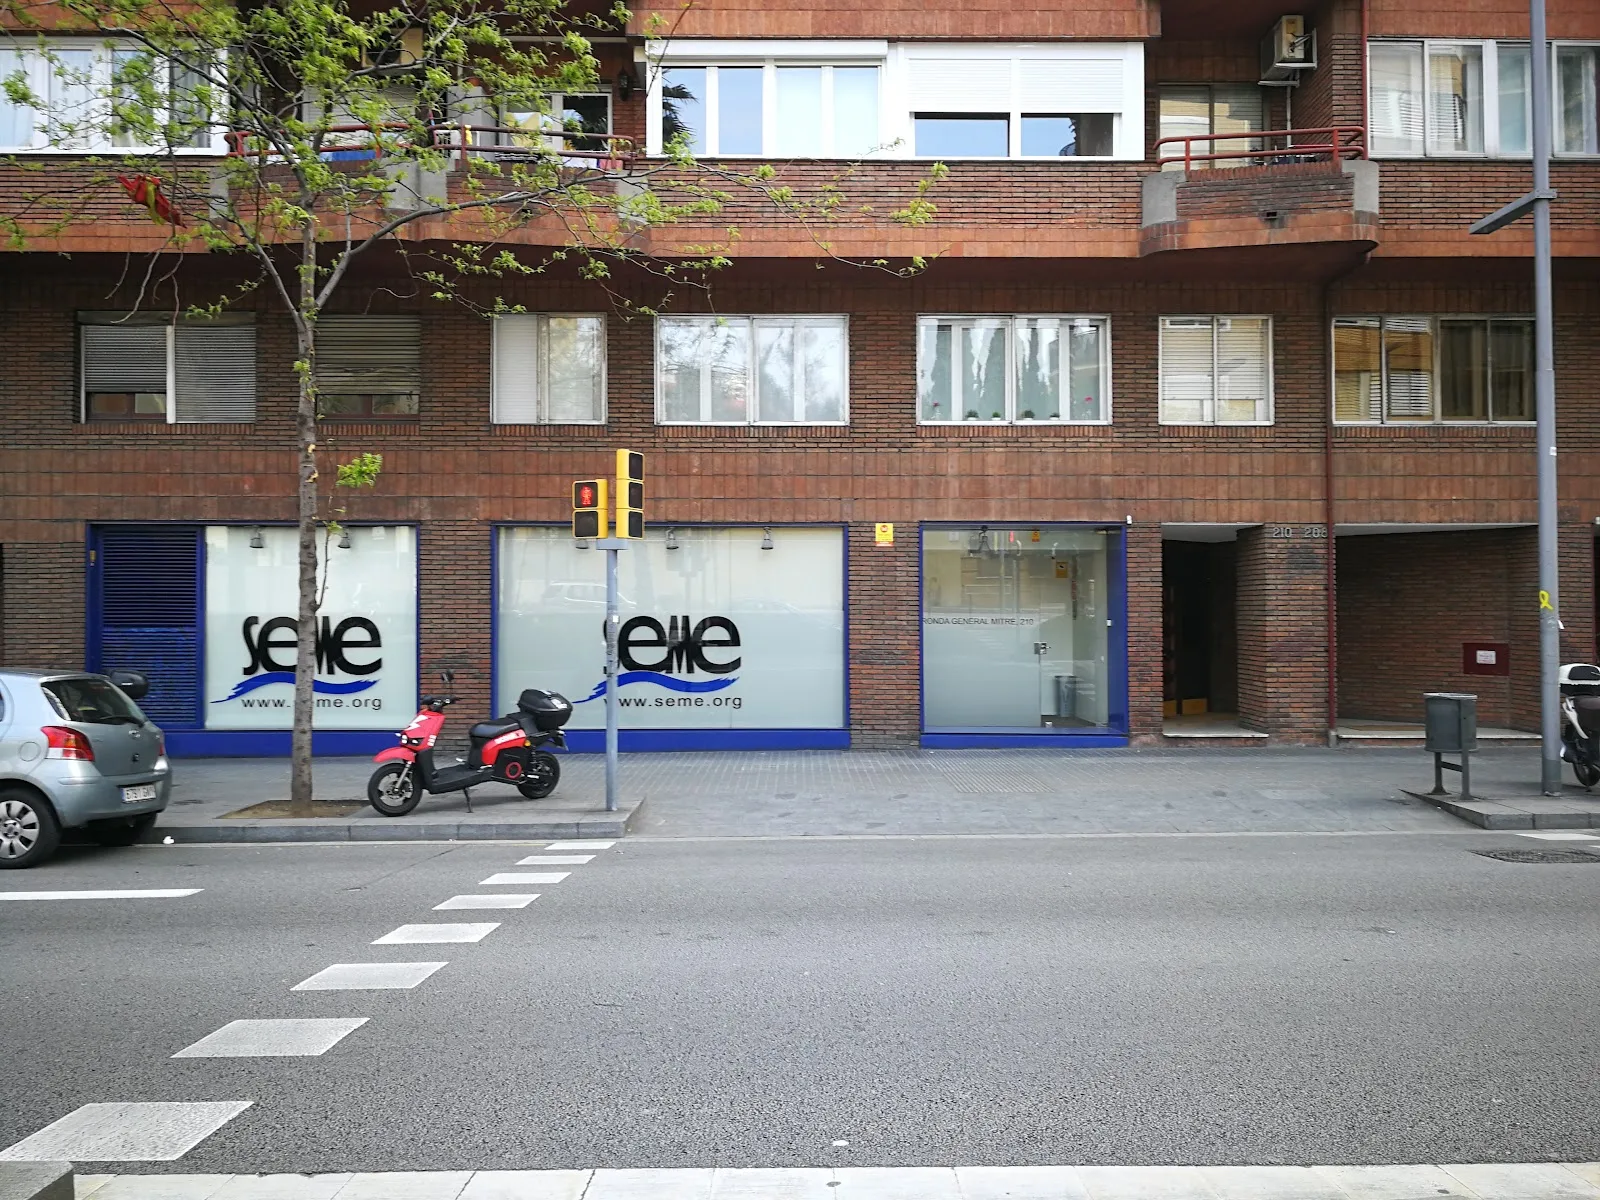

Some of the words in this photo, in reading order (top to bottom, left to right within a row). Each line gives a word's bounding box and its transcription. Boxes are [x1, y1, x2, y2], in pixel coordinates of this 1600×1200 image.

[1272, 527, 1292, 538] 210
[1304, 527, 1328, 538] 208
[922, 617, 950, 625] RONDA
[951, 617, 989, 625] GENERAL
[1019, 618, 1034, 626] 210
[242, 696, 382, 711] www.me.org
